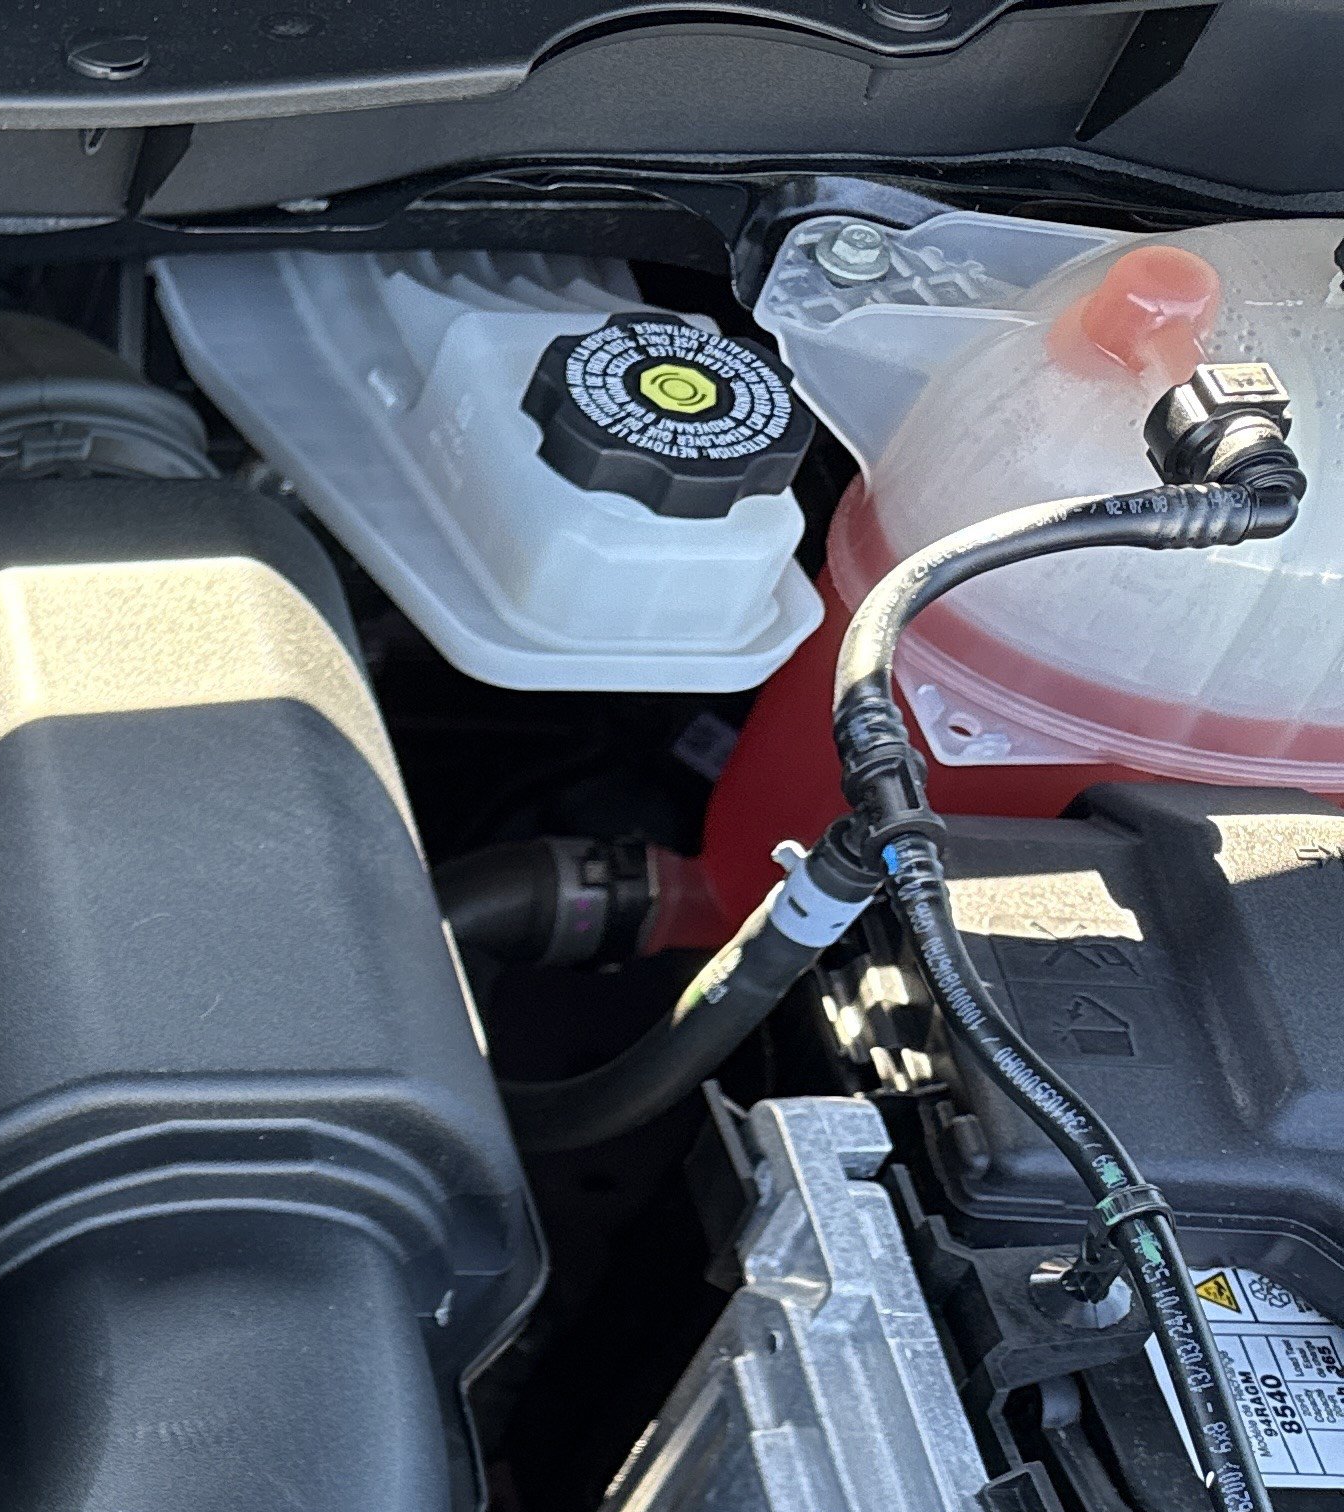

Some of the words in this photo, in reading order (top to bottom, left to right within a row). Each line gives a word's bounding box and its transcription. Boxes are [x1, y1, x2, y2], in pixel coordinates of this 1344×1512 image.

[637, 334, 670, 345] ONLY
[673, 336, 698, 349] USE
[709, 333, 757, 363] SEALED
[571, 347, 591, 360] LA
[646, 345, 695, 360] FILLER
[566, 357, 584, 385] AVANT
[694, 353, 735, 378] CLEAN
[585, 375, 603, 386] DE
[756, 367, 786, 391] FROM
[569, 386, 613, 426] BOUCHON
[749, 382, 771, 415] BEFORE
[772, 392, 791, 418] FLUID
[608, 424, 629, 437] LE
[621, 416, 644, 431] DU
[644, 426, 673, 442] QUE
[656, 417, 736, 435] PROVENANT
[627, 432, 698, 459] NETTOYER
[1237, 1370, 1279, 1437] 94RAGM
[1260, 1374, 1303, 1434] 8540
